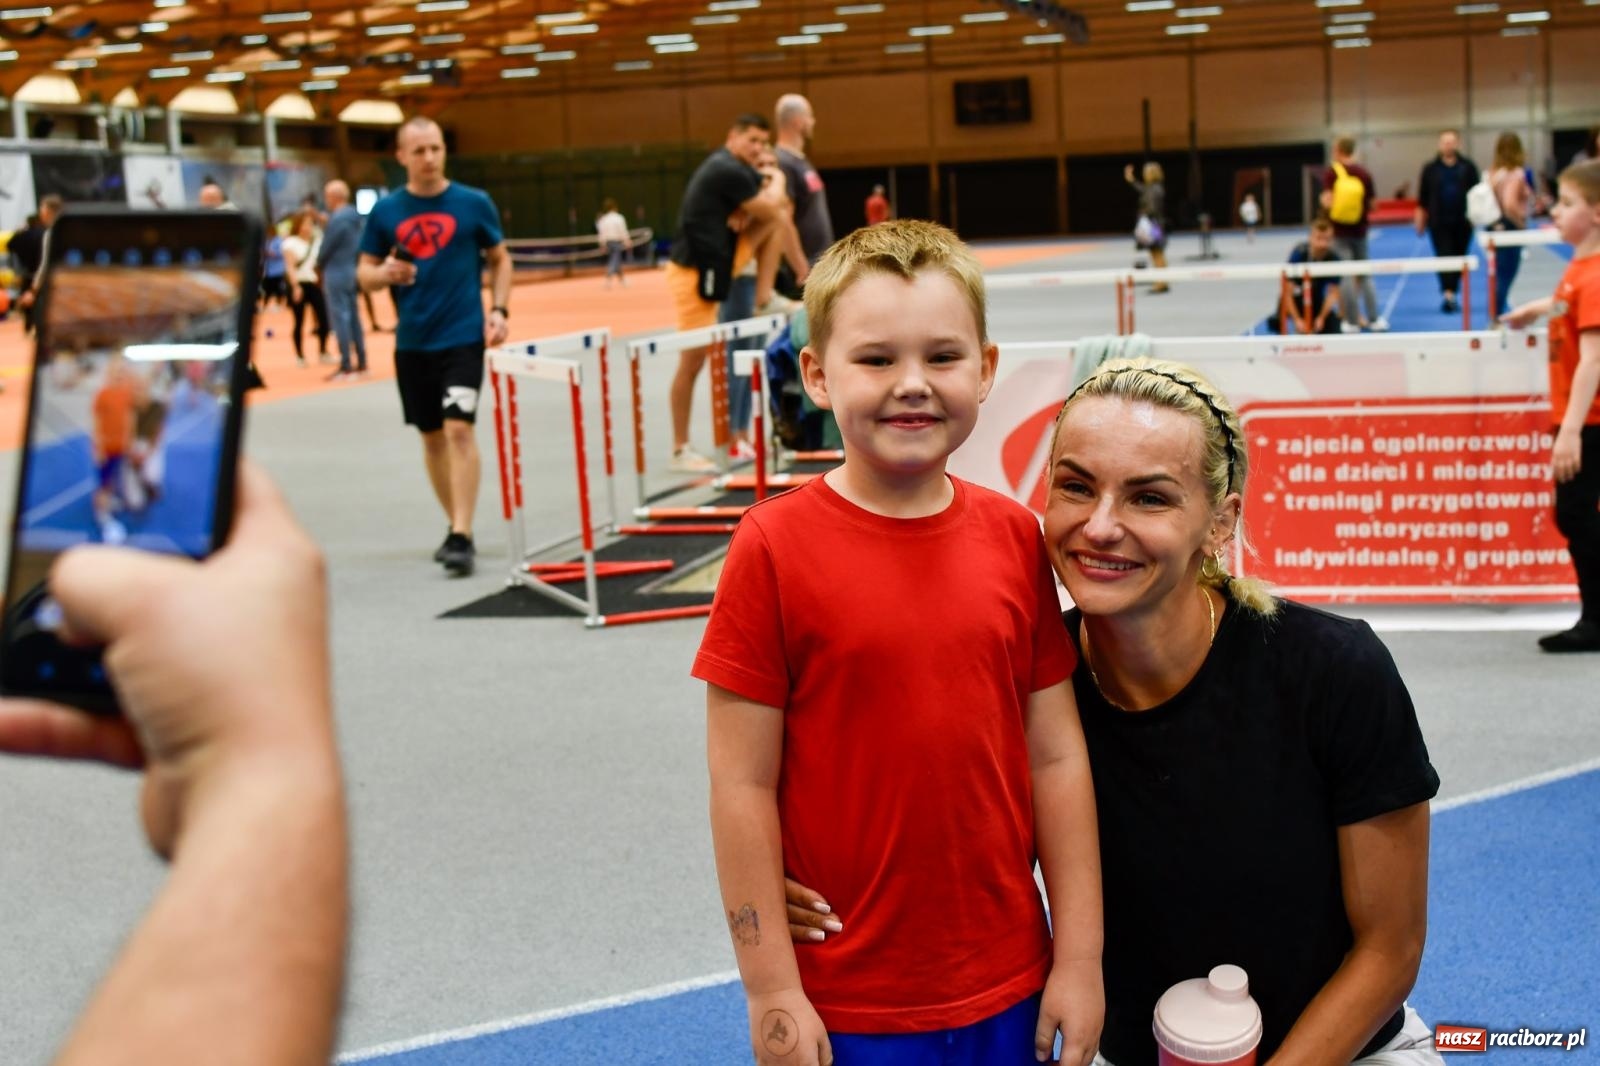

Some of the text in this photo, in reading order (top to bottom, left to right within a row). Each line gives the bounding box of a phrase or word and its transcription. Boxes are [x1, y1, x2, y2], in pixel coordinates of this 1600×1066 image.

[1288, 463, 1327, 482] dla
[1334, 461, 1408, 482] dzieci
[1416, 461, 1425, 481] i
[1284, 490, 1383, 514] treningi
[1335, 520, 1509, 541] motorycznego
[1275, 547, 1439, 571] indywidualne
[1447, 547, 1456, 566] i
